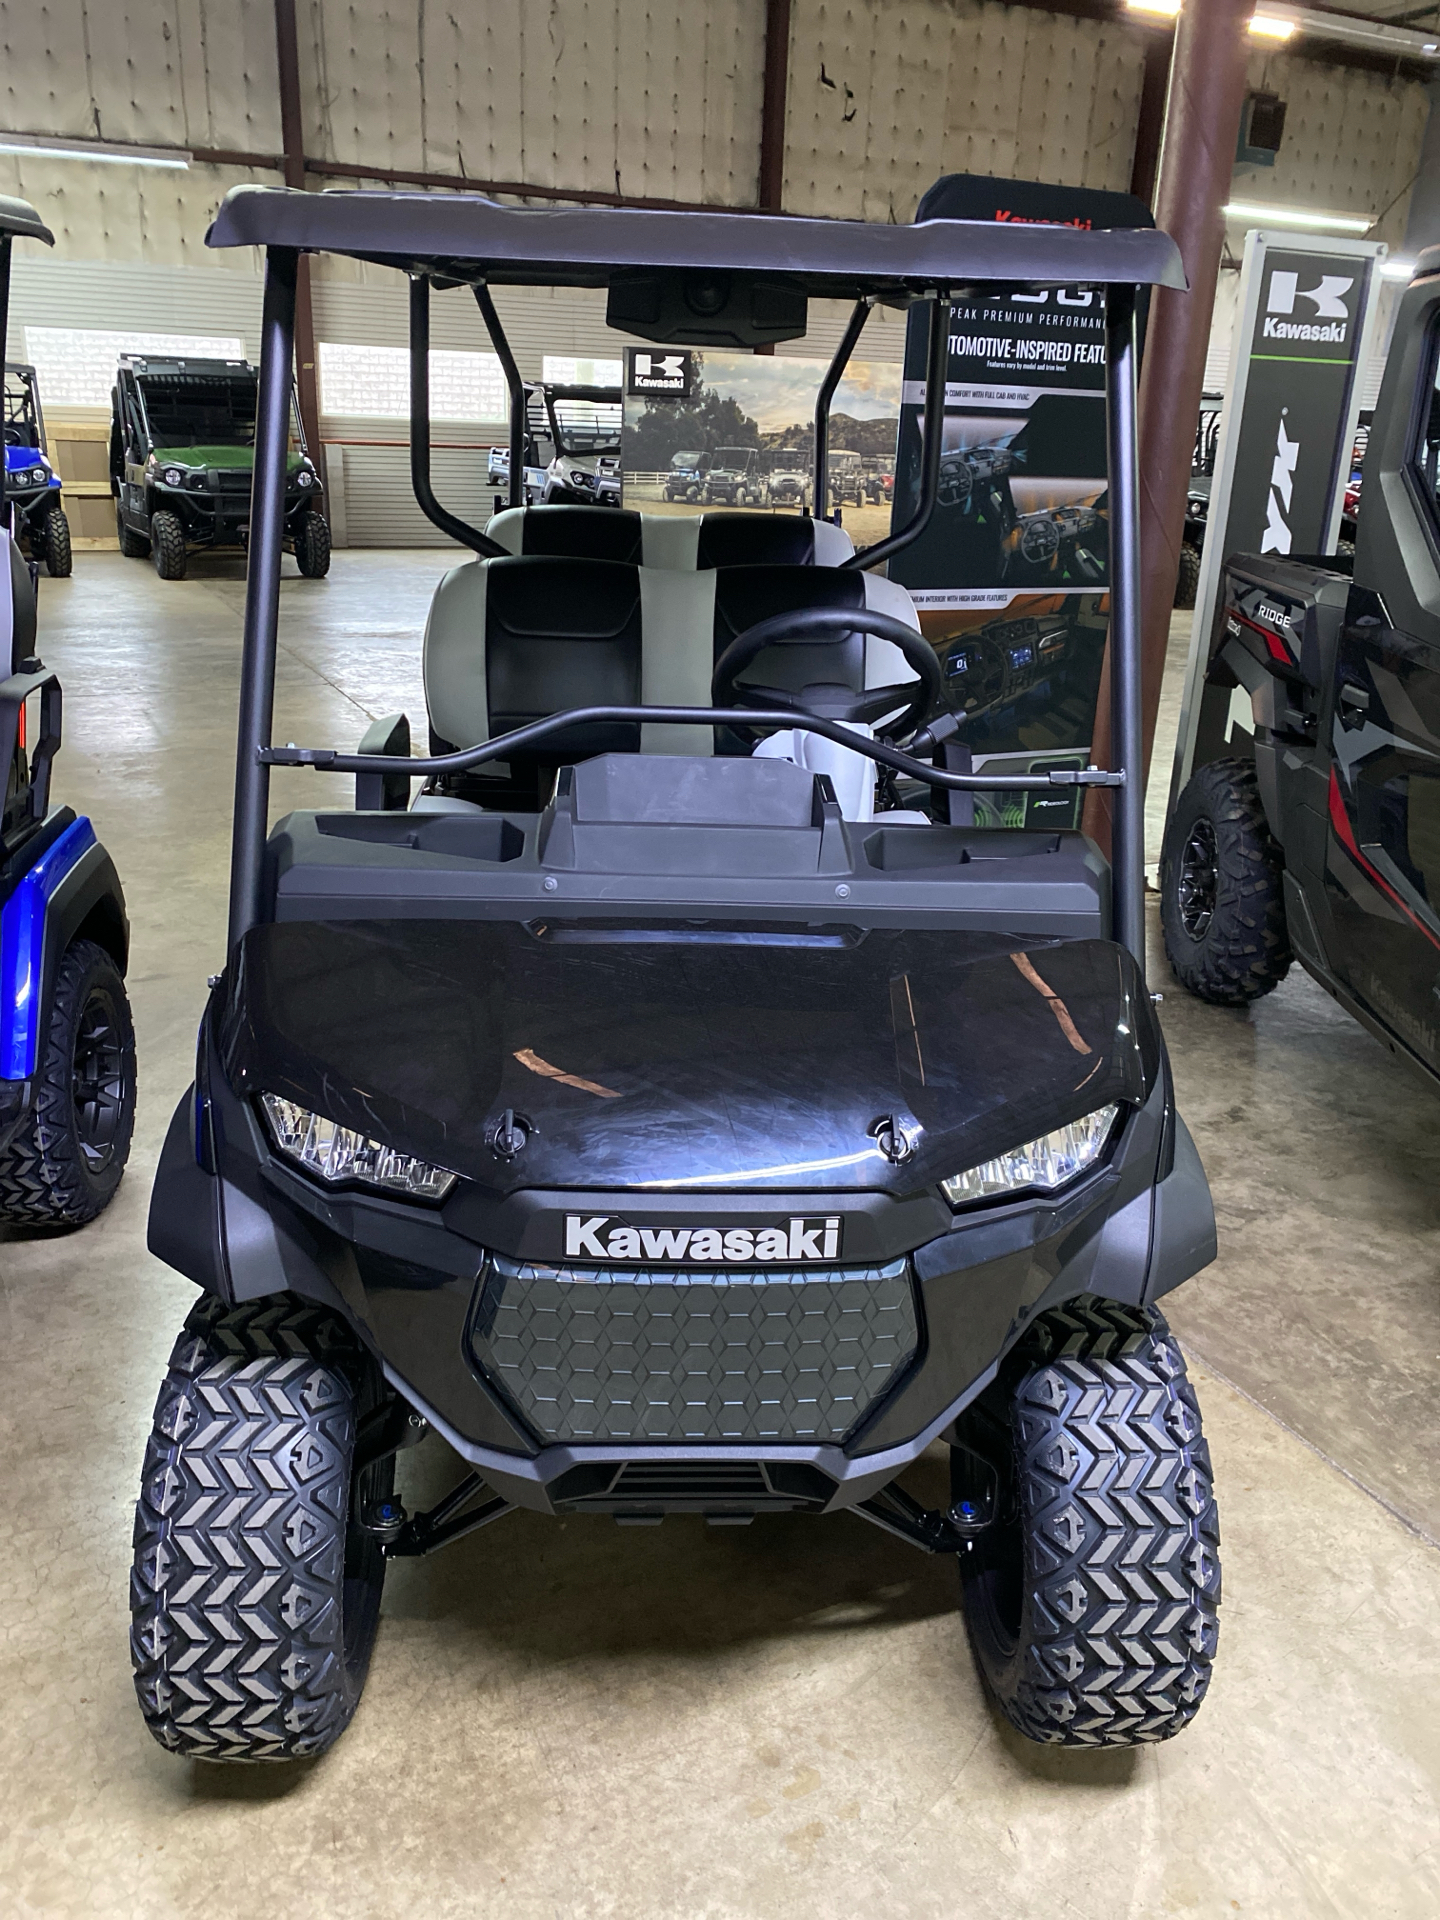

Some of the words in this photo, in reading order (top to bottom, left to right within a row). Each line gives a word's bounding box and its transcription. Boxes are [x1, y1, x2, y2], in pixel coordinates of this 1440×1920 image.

[950, 307, 977, 320] PEAK
[983, 309, 1033, 324] PREMIUM
[1039, 313, 1105, 329] PERFORMAN
[1263, 317, 1347, 342] Kawasaki
[948, 335, 1071, 362] TOMOTIVE-INSPIRED
[1073, 343, 1106, 364] FEATU
[986, 360, 1006, 369] Features
[1006, 362, 1016, 370] vary
[1016, 362, 1022, 370] by
[1036, 363, 1045, 371] and
[635, 376, 684, 389] Kawasaki
[949, 389, 971, 397] COMFORT
[971, 390, 985, 398] WITH
[985, 391, 995, 399] FULL
[996, 391, 1006, 399] CAB
[1006, 392, 1016, 400] AND
[1017, 392, 1030, 400] HVAC
[910, 595, 924, 603] MIUM
[925, 595, 946, 603] INTERIOR
[970, 594, 985, 602] GRADE
[1258, 605, 1291, 628] RIDGE
[565, 1216, 839, 1260] Kawasaki
